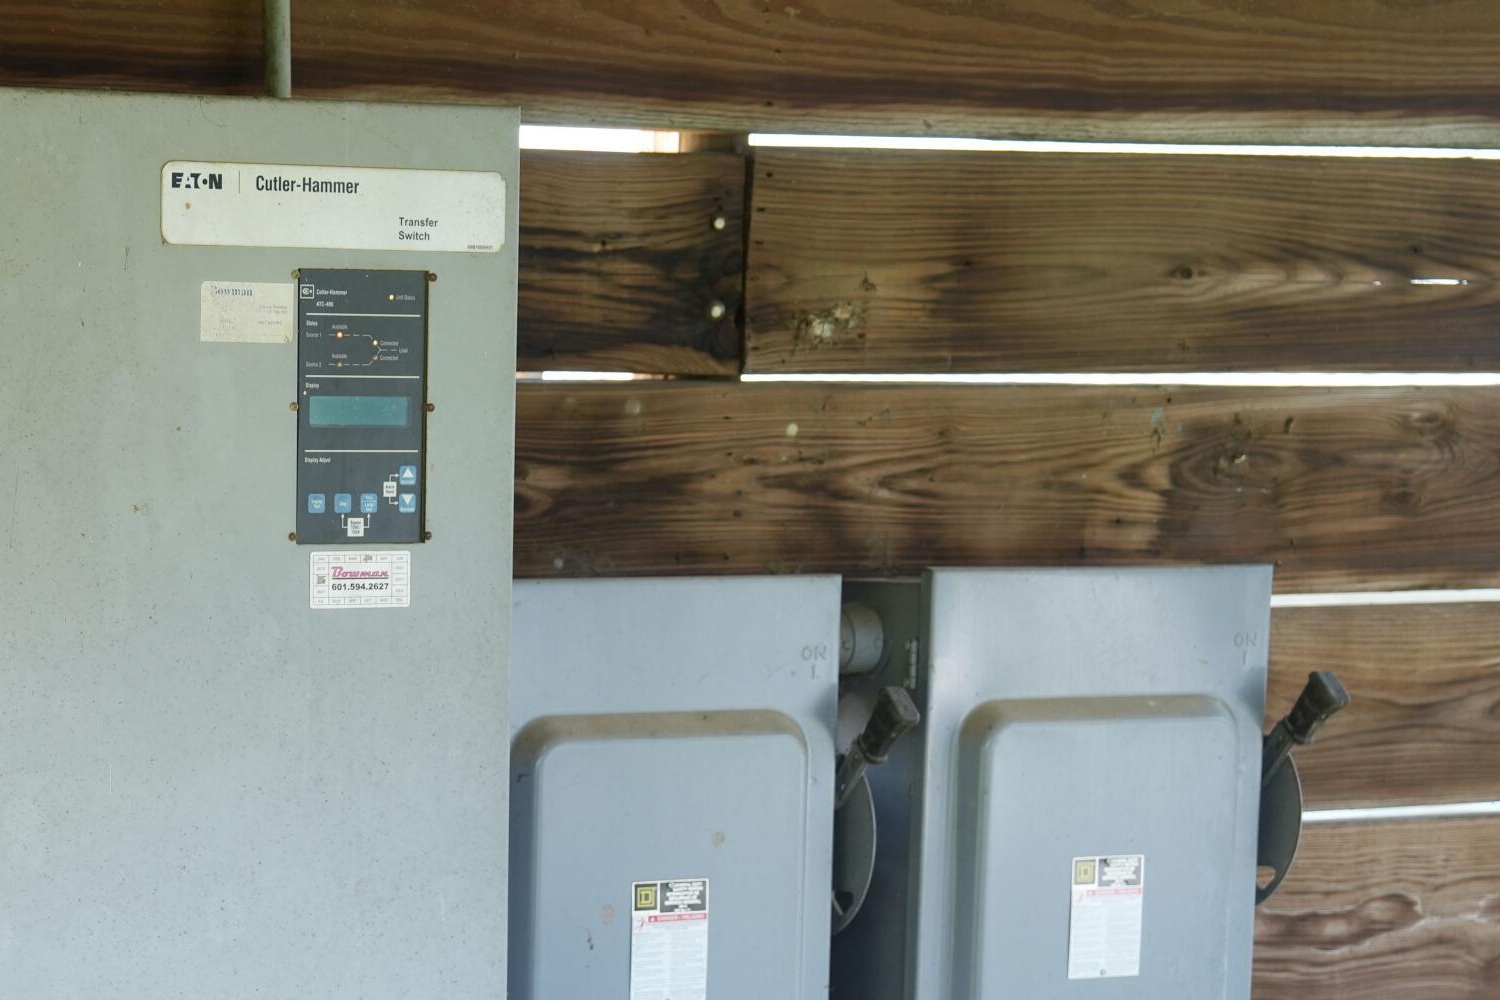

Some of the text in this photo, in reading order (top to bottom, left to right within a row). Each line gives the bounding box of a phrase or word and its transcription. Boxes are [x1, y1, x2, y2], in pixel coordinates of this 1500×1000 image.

[255, 175, 360, 194] Cutler-Hammer
[399, 216, 439, 227] Transfer
[398, 230, 430, 241] Switch
[316, 288, 348, 296] Cutler-Hammer
[331, 583, 389, 591] 601.594.2627
